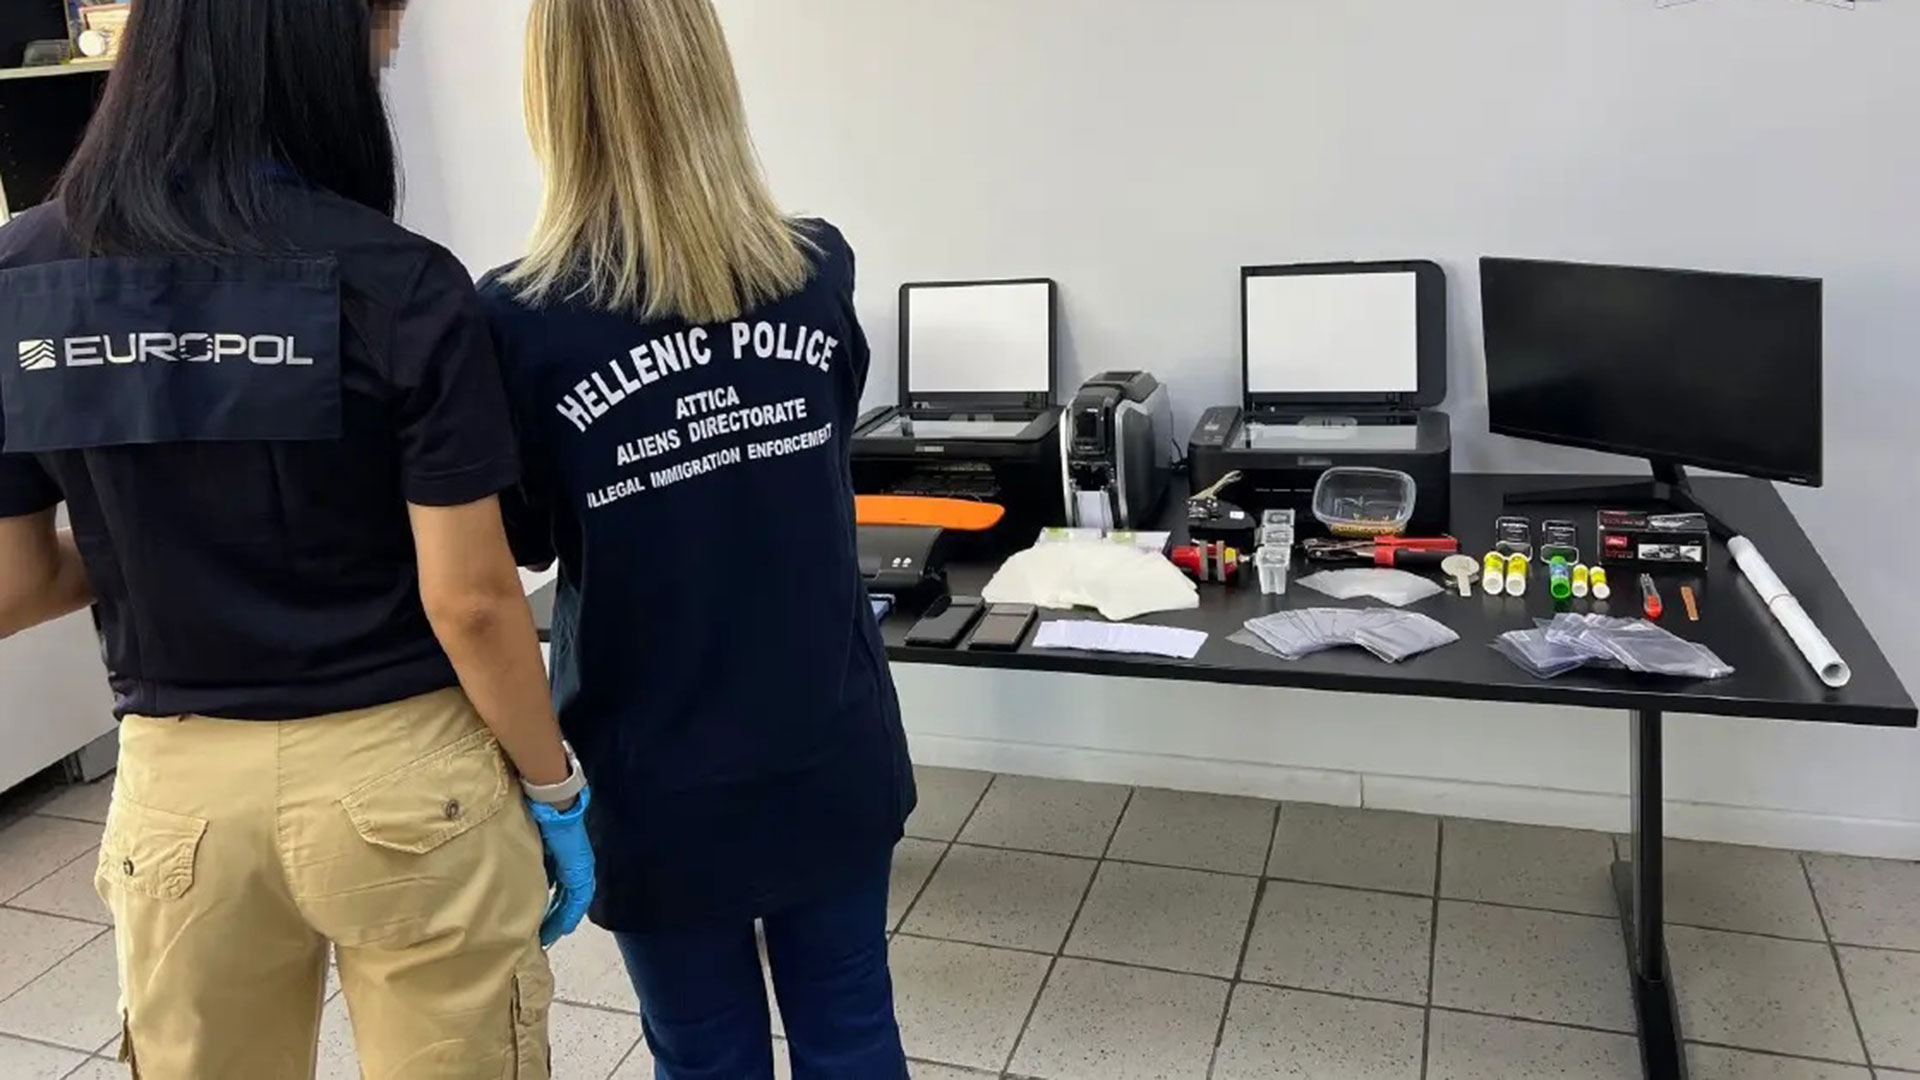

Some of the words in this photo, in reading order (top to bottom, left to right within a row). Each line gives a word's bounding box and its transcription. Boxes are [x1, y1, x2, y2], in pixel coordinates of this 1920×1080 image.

[64, 332, 313, 366] EUROPOL
[556, 327, 711, 432] HELLENIC
[732, 321, 838, 372] POLICE
[616, 428, 681, 466] ALIENS
[688, 397, 807, 443] DIRECTORATE
[676, 385, 740, 419] ATTICA
[587, 477, 645, 508] ILLEGAL
[650, 447, 741, 489] IMMIGRATION
[747, 423, 833, 460] ENFORCEMENT
